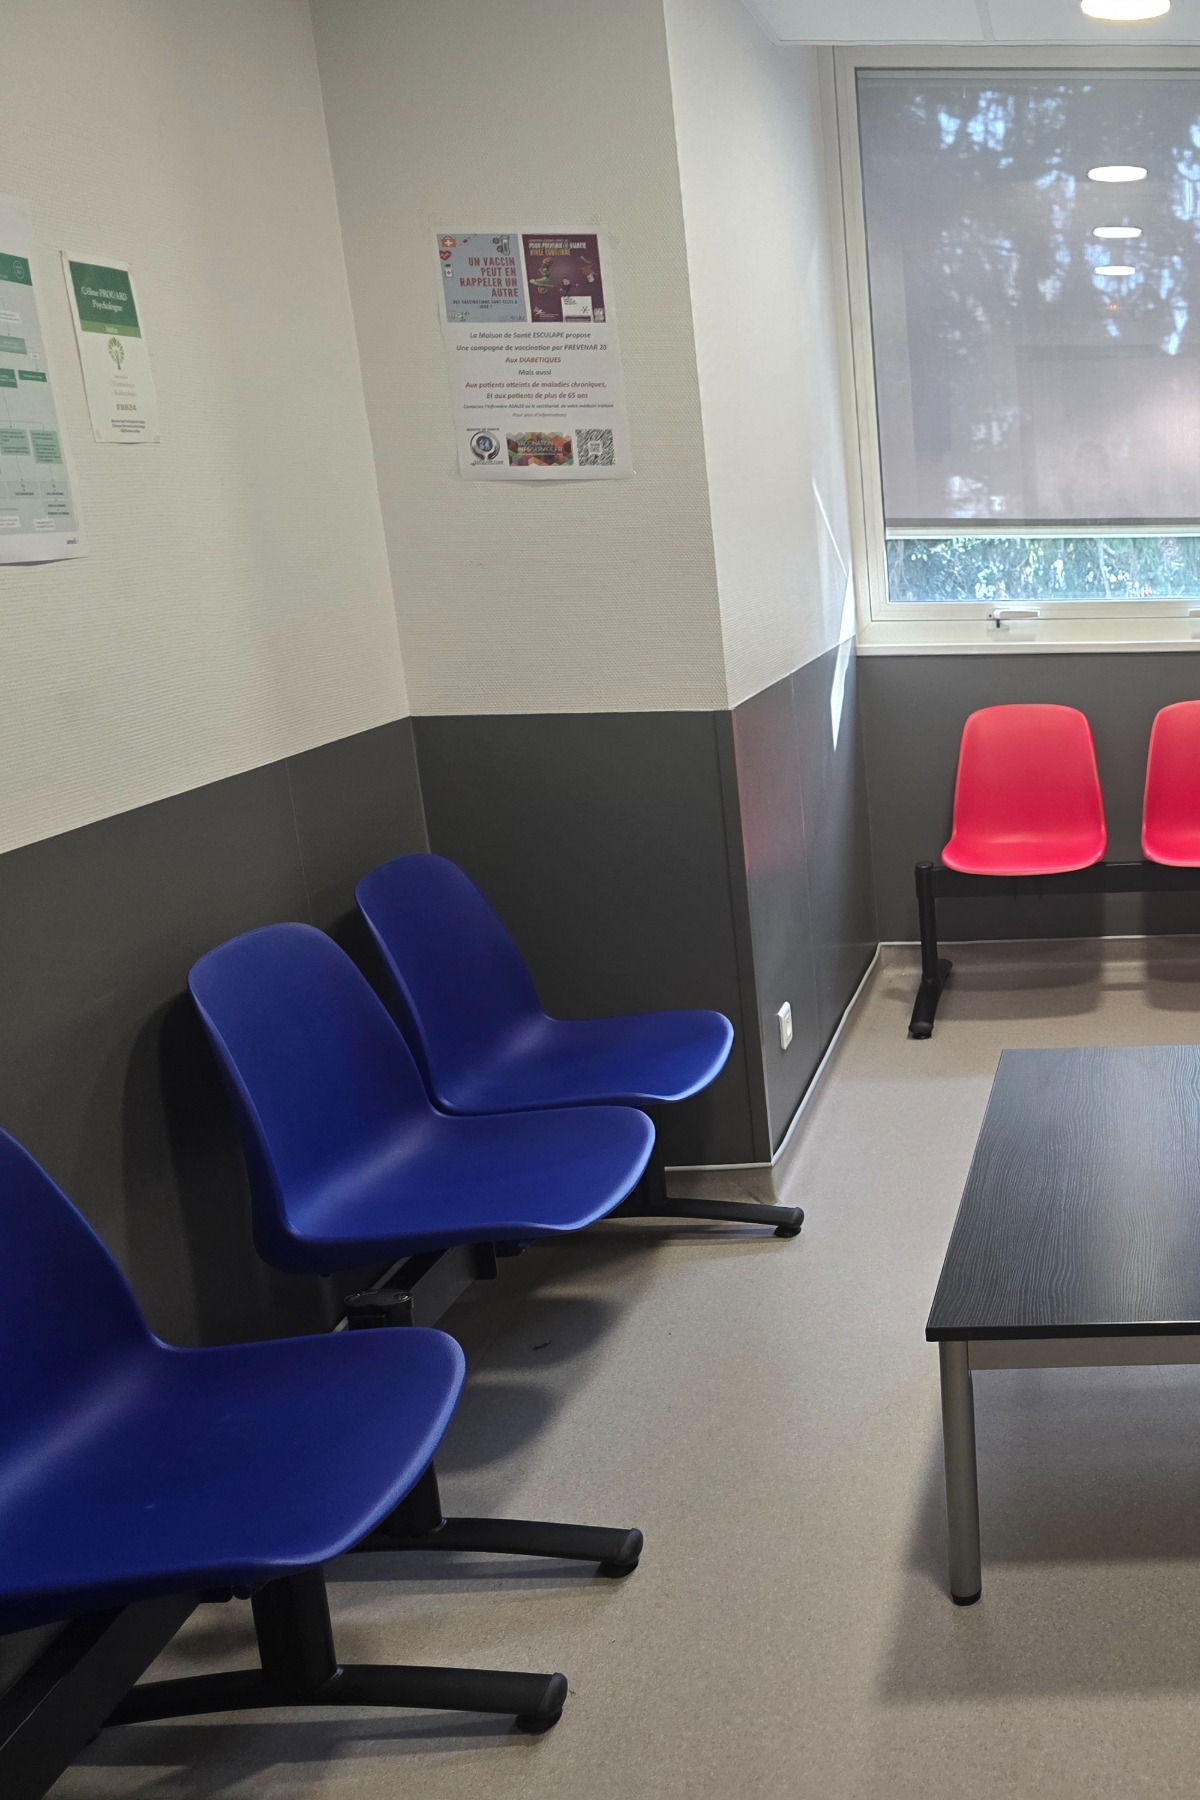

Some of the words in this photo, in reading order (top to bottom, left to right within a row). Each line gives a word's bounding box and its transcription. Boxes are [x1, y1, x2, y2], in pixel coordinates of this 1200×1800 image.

[468, 257, 480, 266] UN
[483, 257, 515, 266] VACCIN
[480, 268, 502, 276] PEUT
[505, 268, 516, 276] EN
[460, 278, 502, 287] RAPPELER
[506, 278, 518, 287] UN
[492, 288, 519, 298] AUTRE
[508, 392, 534, 400] patients
[544, 392, 558, 400] plus
